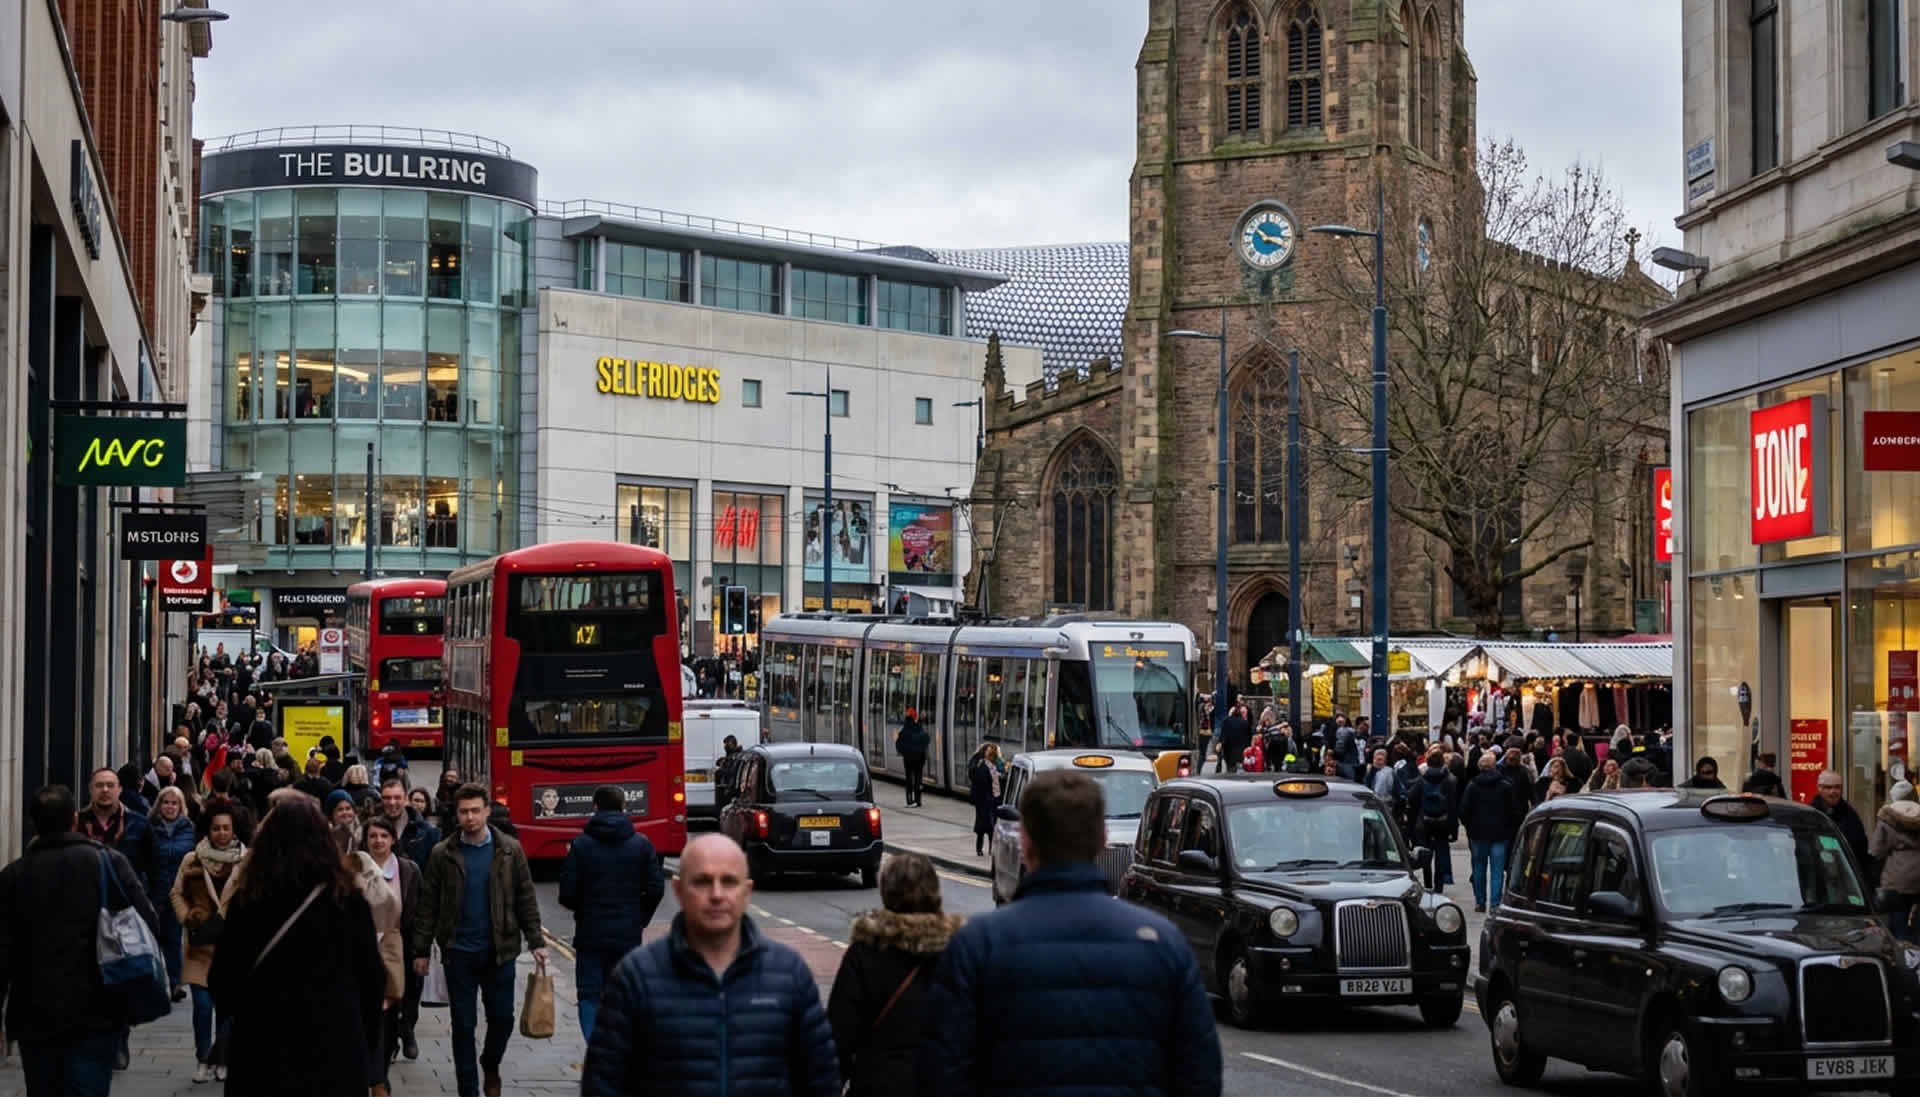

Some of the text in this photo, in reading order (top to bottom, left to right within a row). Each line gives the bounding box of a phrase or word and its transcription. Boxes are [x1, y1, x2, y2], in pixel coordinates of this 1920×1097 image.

[279, 152, 486, 185] THE BULLRING
[597, 356, 720, 404] SELFRIDGES
[1815, 1058, 1887, 1076] EV88 JEK
